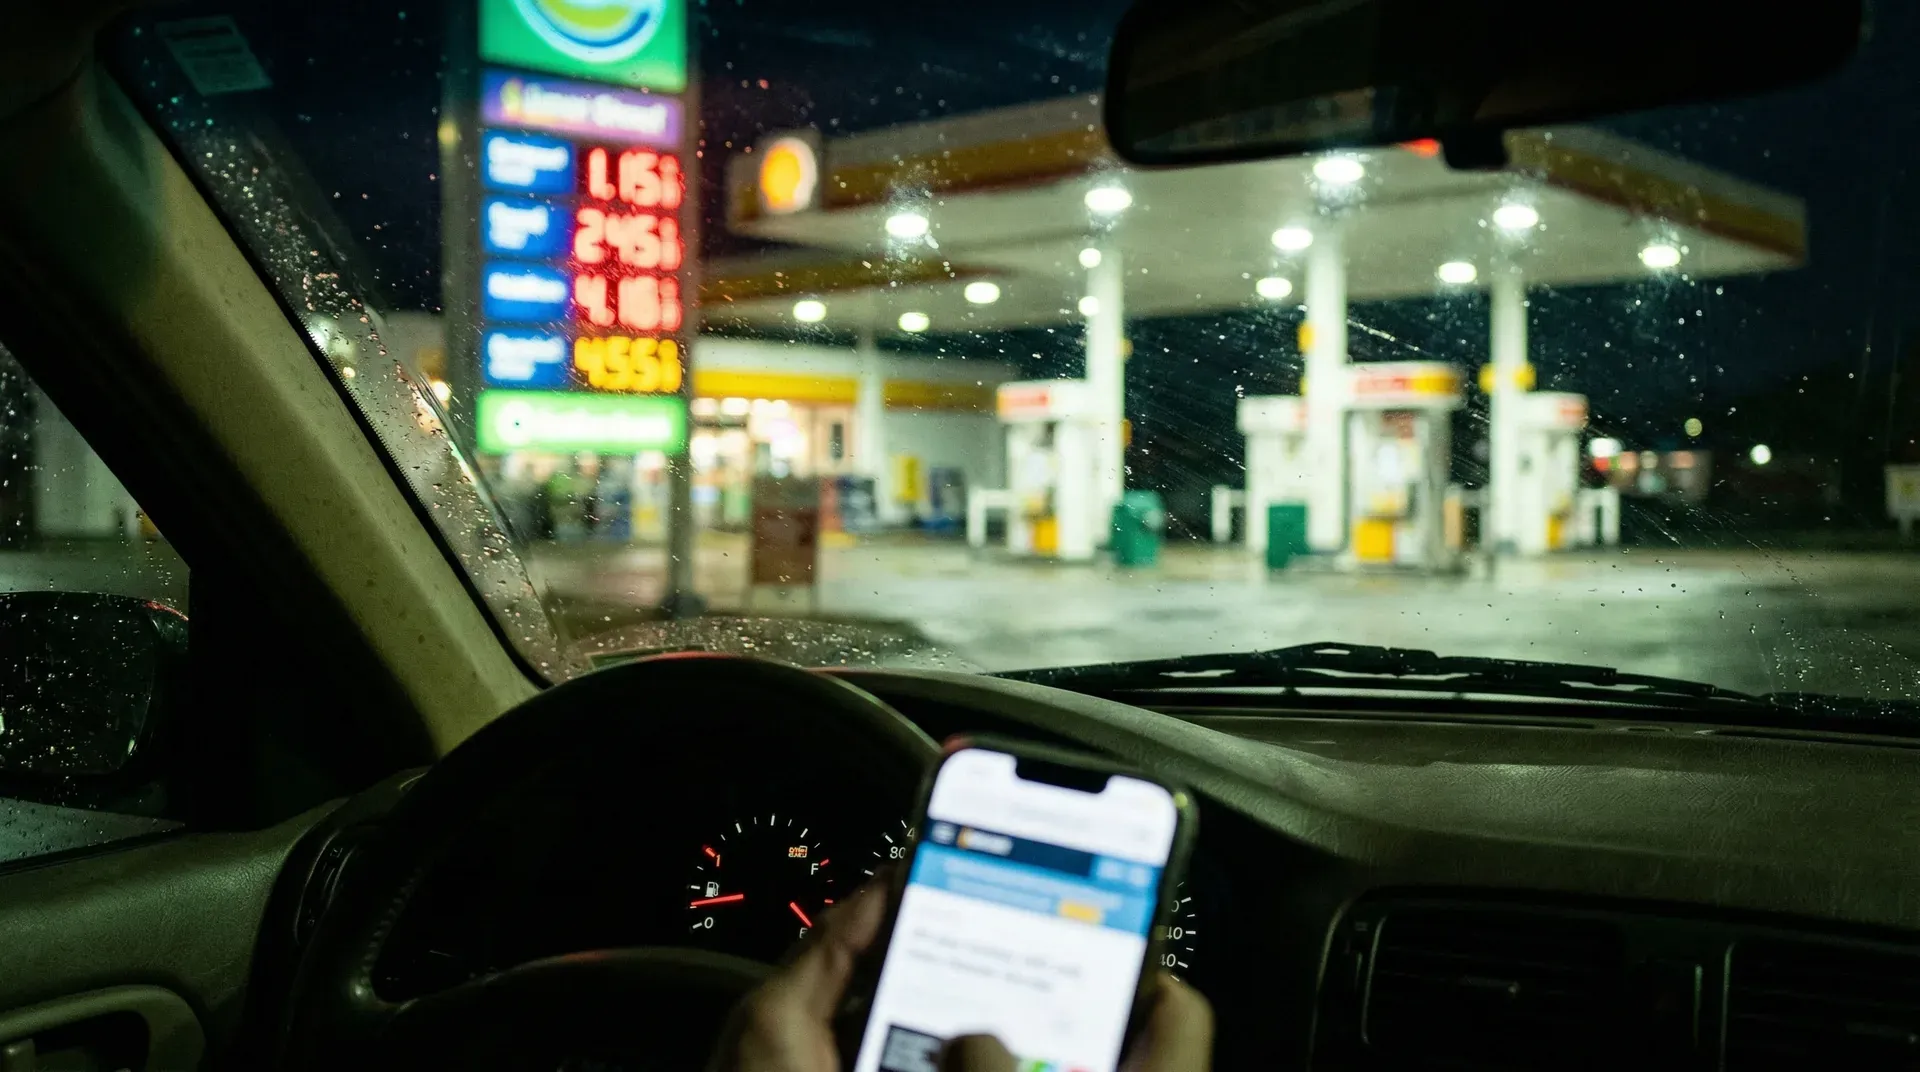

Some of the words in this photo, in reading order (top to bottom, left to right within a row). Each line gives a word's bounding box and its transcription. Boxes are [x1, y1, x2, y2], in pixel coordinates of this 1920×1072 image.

[889, 846, 906, 859] 80
[716, 854, 721, 867] 1
[810, 862, 819, 876] F
